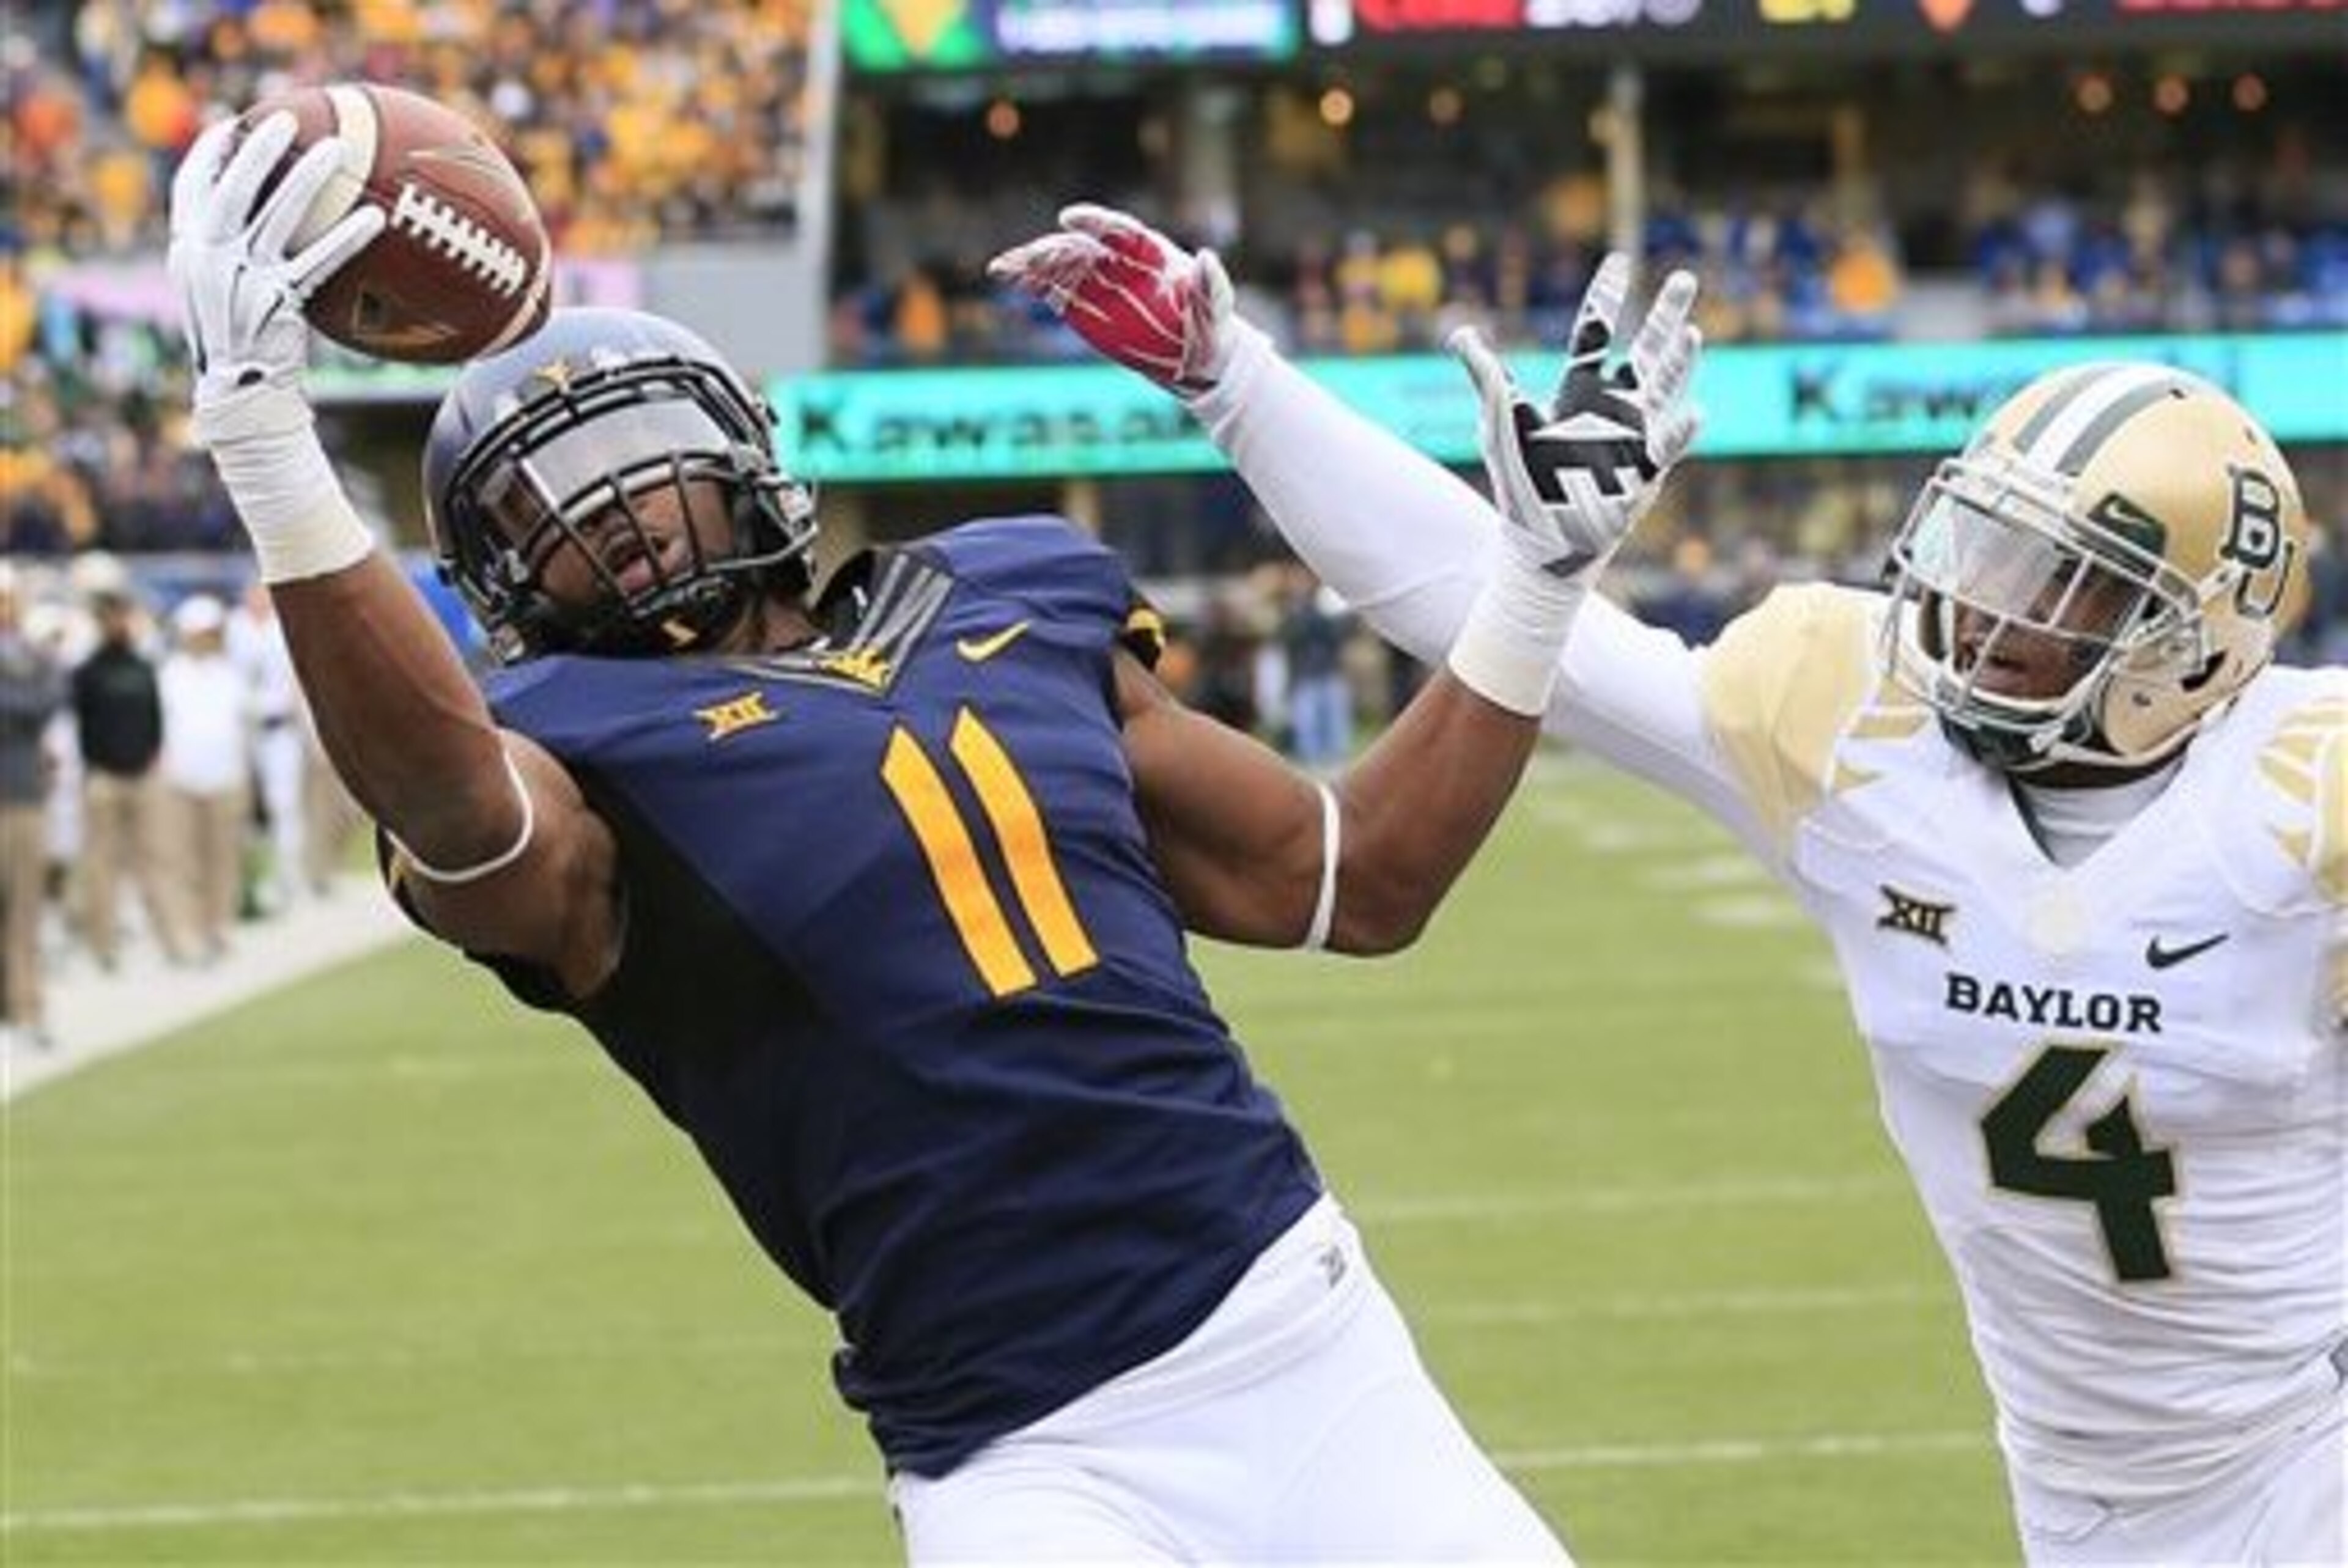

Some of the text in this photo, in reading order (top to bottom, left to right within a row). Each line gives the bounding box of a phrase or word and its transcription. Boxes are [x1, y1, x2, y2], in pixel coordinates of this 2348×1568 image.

[880, 705, 1100, 999] 11
[1943, 971, 2165, 1034] BAYLOR
[1979, 1042, 2177, 1285] 4
